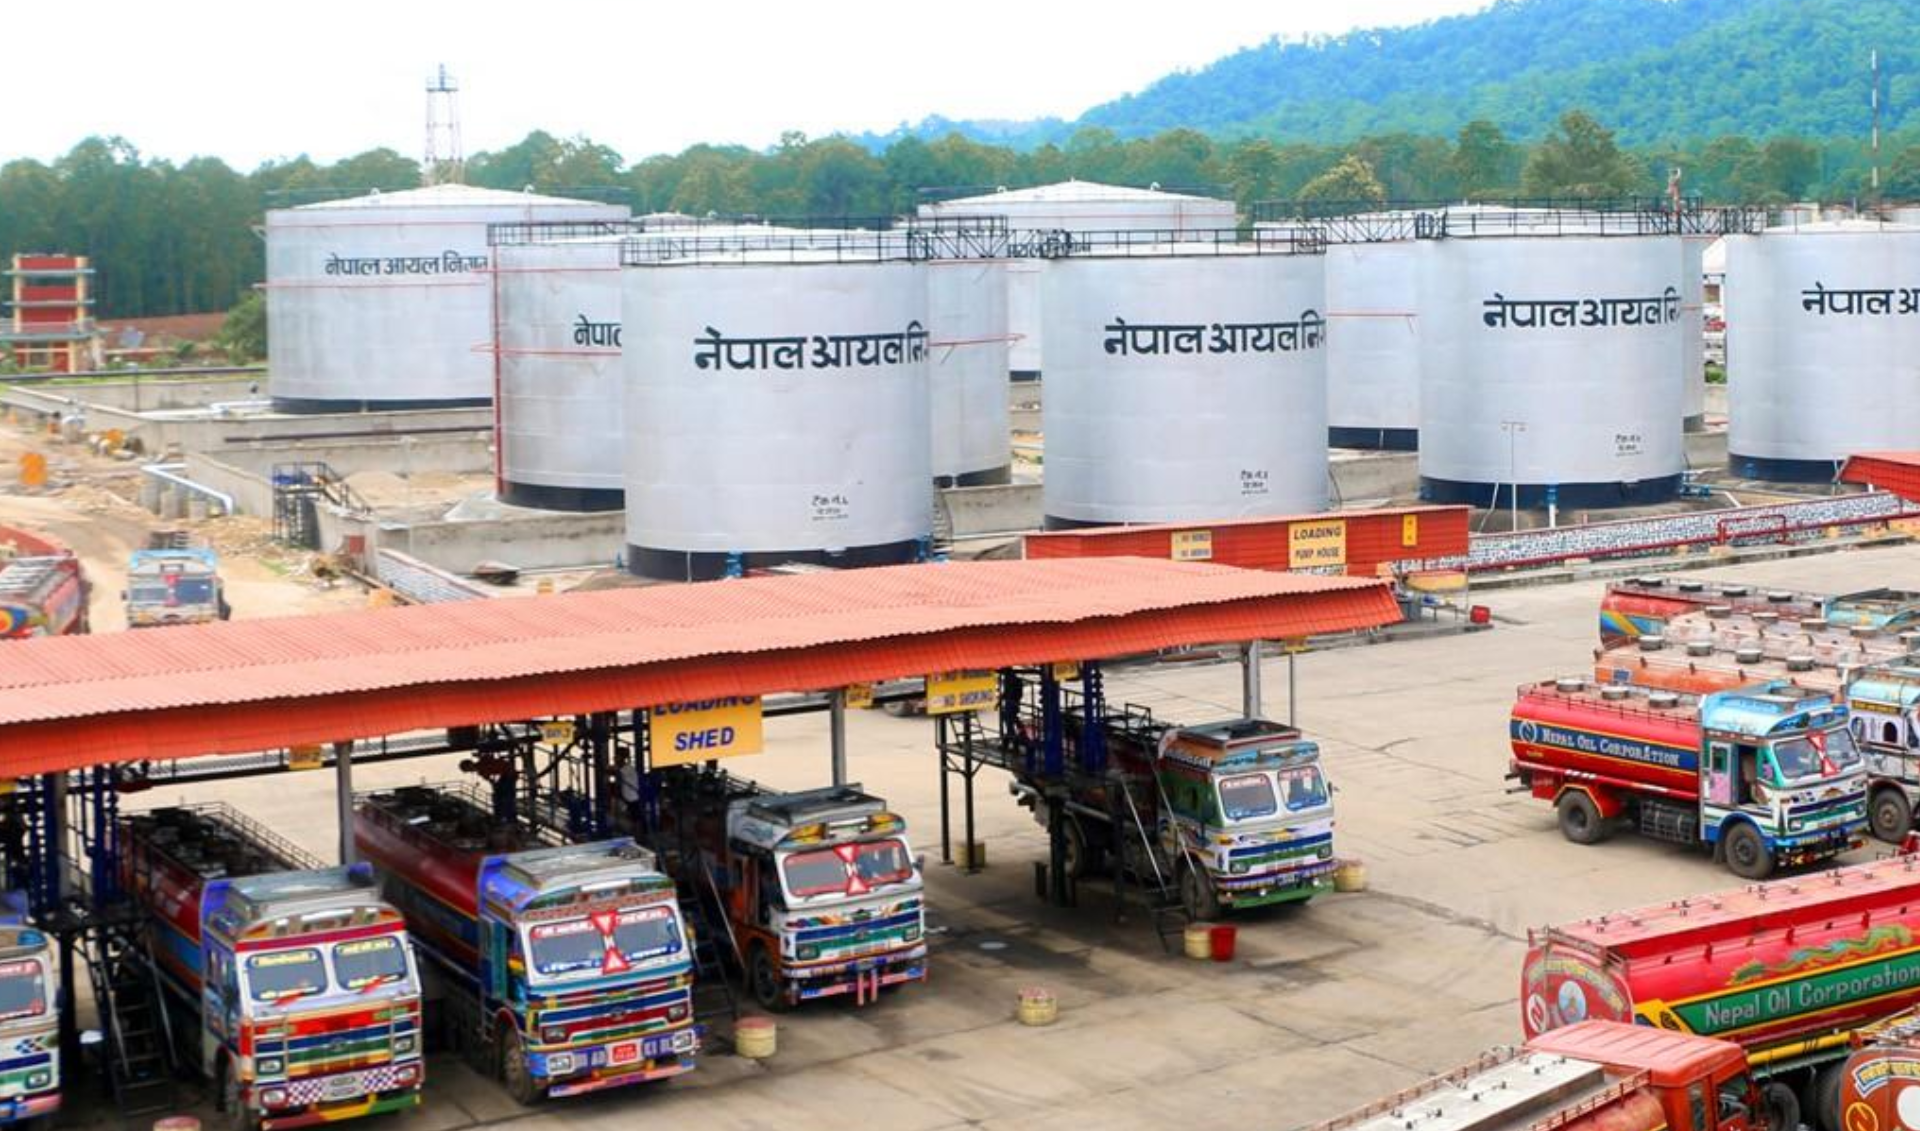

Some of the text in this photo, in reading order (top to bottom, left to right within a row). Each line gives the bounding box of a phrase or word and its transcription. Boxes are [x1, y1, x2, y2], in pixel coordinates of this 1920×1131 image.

[325, 252, 380, 275] नेपाल
[384, 257, 439, 274] आयल
[1483, 292, 1580, 328] नेपाल
[1580, 297, 1662, 327] आयल
[1801, 281, 1895, 315] नेपाल
[694, 326, 807, 370] नेपाल
[811, 333, 905, 368] आयल
[1104, 317, 1206, 355] नेपाल
[1208, 322, 1299, 353] आयल
[1294, 526, 1341, 540] LOADING
[674, 726, 734, 751] SHED
[1705, 965, 1920, 1028] Nepal Oil Corporation
